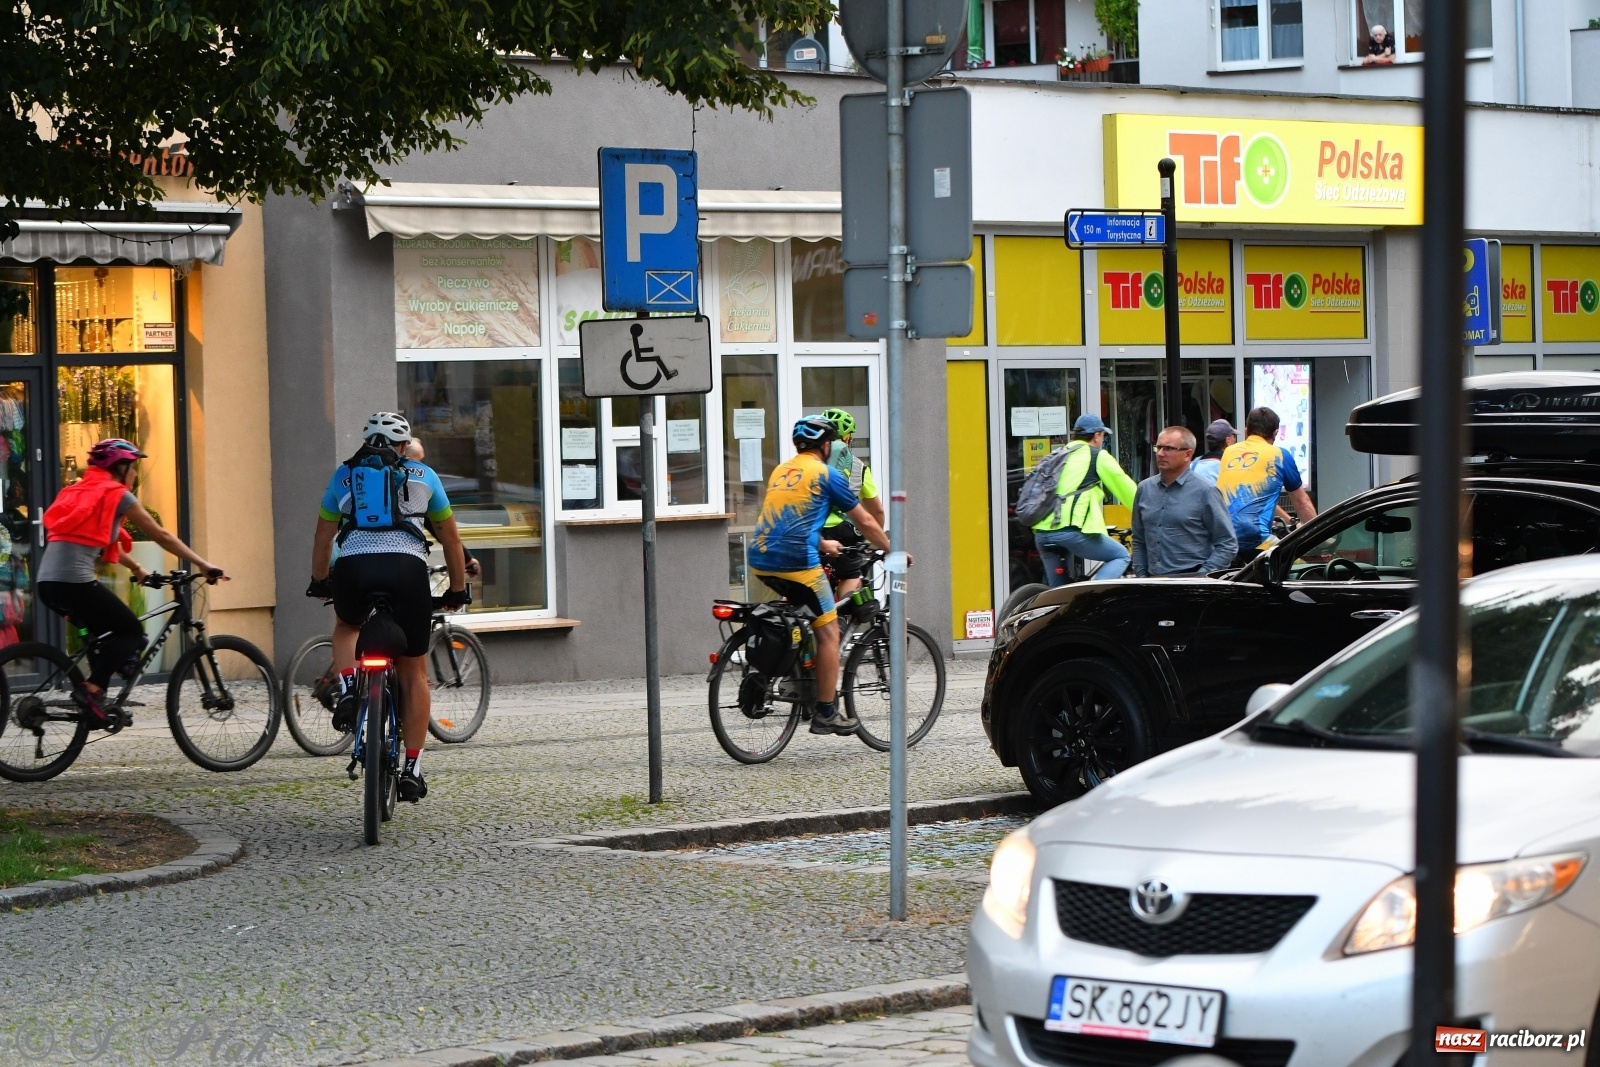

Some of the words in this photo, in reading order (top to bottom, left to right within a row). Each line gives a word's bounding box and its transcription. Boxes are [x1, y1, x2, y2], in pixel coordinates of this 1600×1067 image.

[1317, 138, 1404, 181] Polska
[1314, 182, 1340, 200] Sieć
[1343, 182, 1406, 203] Odzieżowa
[625, 163, 678, 263] P
[1106, 217, 1140, 228] Informacja
[1083, 225, 1094, 234] 150
[1106, 230, 1142, 241] Turystyczna
[393, 239, 437, 249] ATURALNE
[438, 239, 480, 249] PRODUKTY
[483, 239, 533, 249] RACIBORSKIE
[422, 256, 438, 267] bez
[441, 256, 503, 267] konserwantów
[437, 276, 490, 290] Pieczywo
[1311, 272, 1360, 295] Polska
[408, 299, 451, 314] Wyroby
[454, 299, 519, 311] cukiernicze
[1188, 296, 1225, 308] Odzieżowa
[1310, 296, 1325, 307] Sieć
[1326, 296, 1361, 308] Odzieżowa
[1502, 302, 1527, 311] zieżowa
[728, 306, 770, 318] Piekarnia
[444, 322, 486, 337] Napoje
[727, 320, 771, 333] Cukiernia
[1067, 984, 1108, 1022] SK
[1118, 989, 1214, 1032] 862JY
